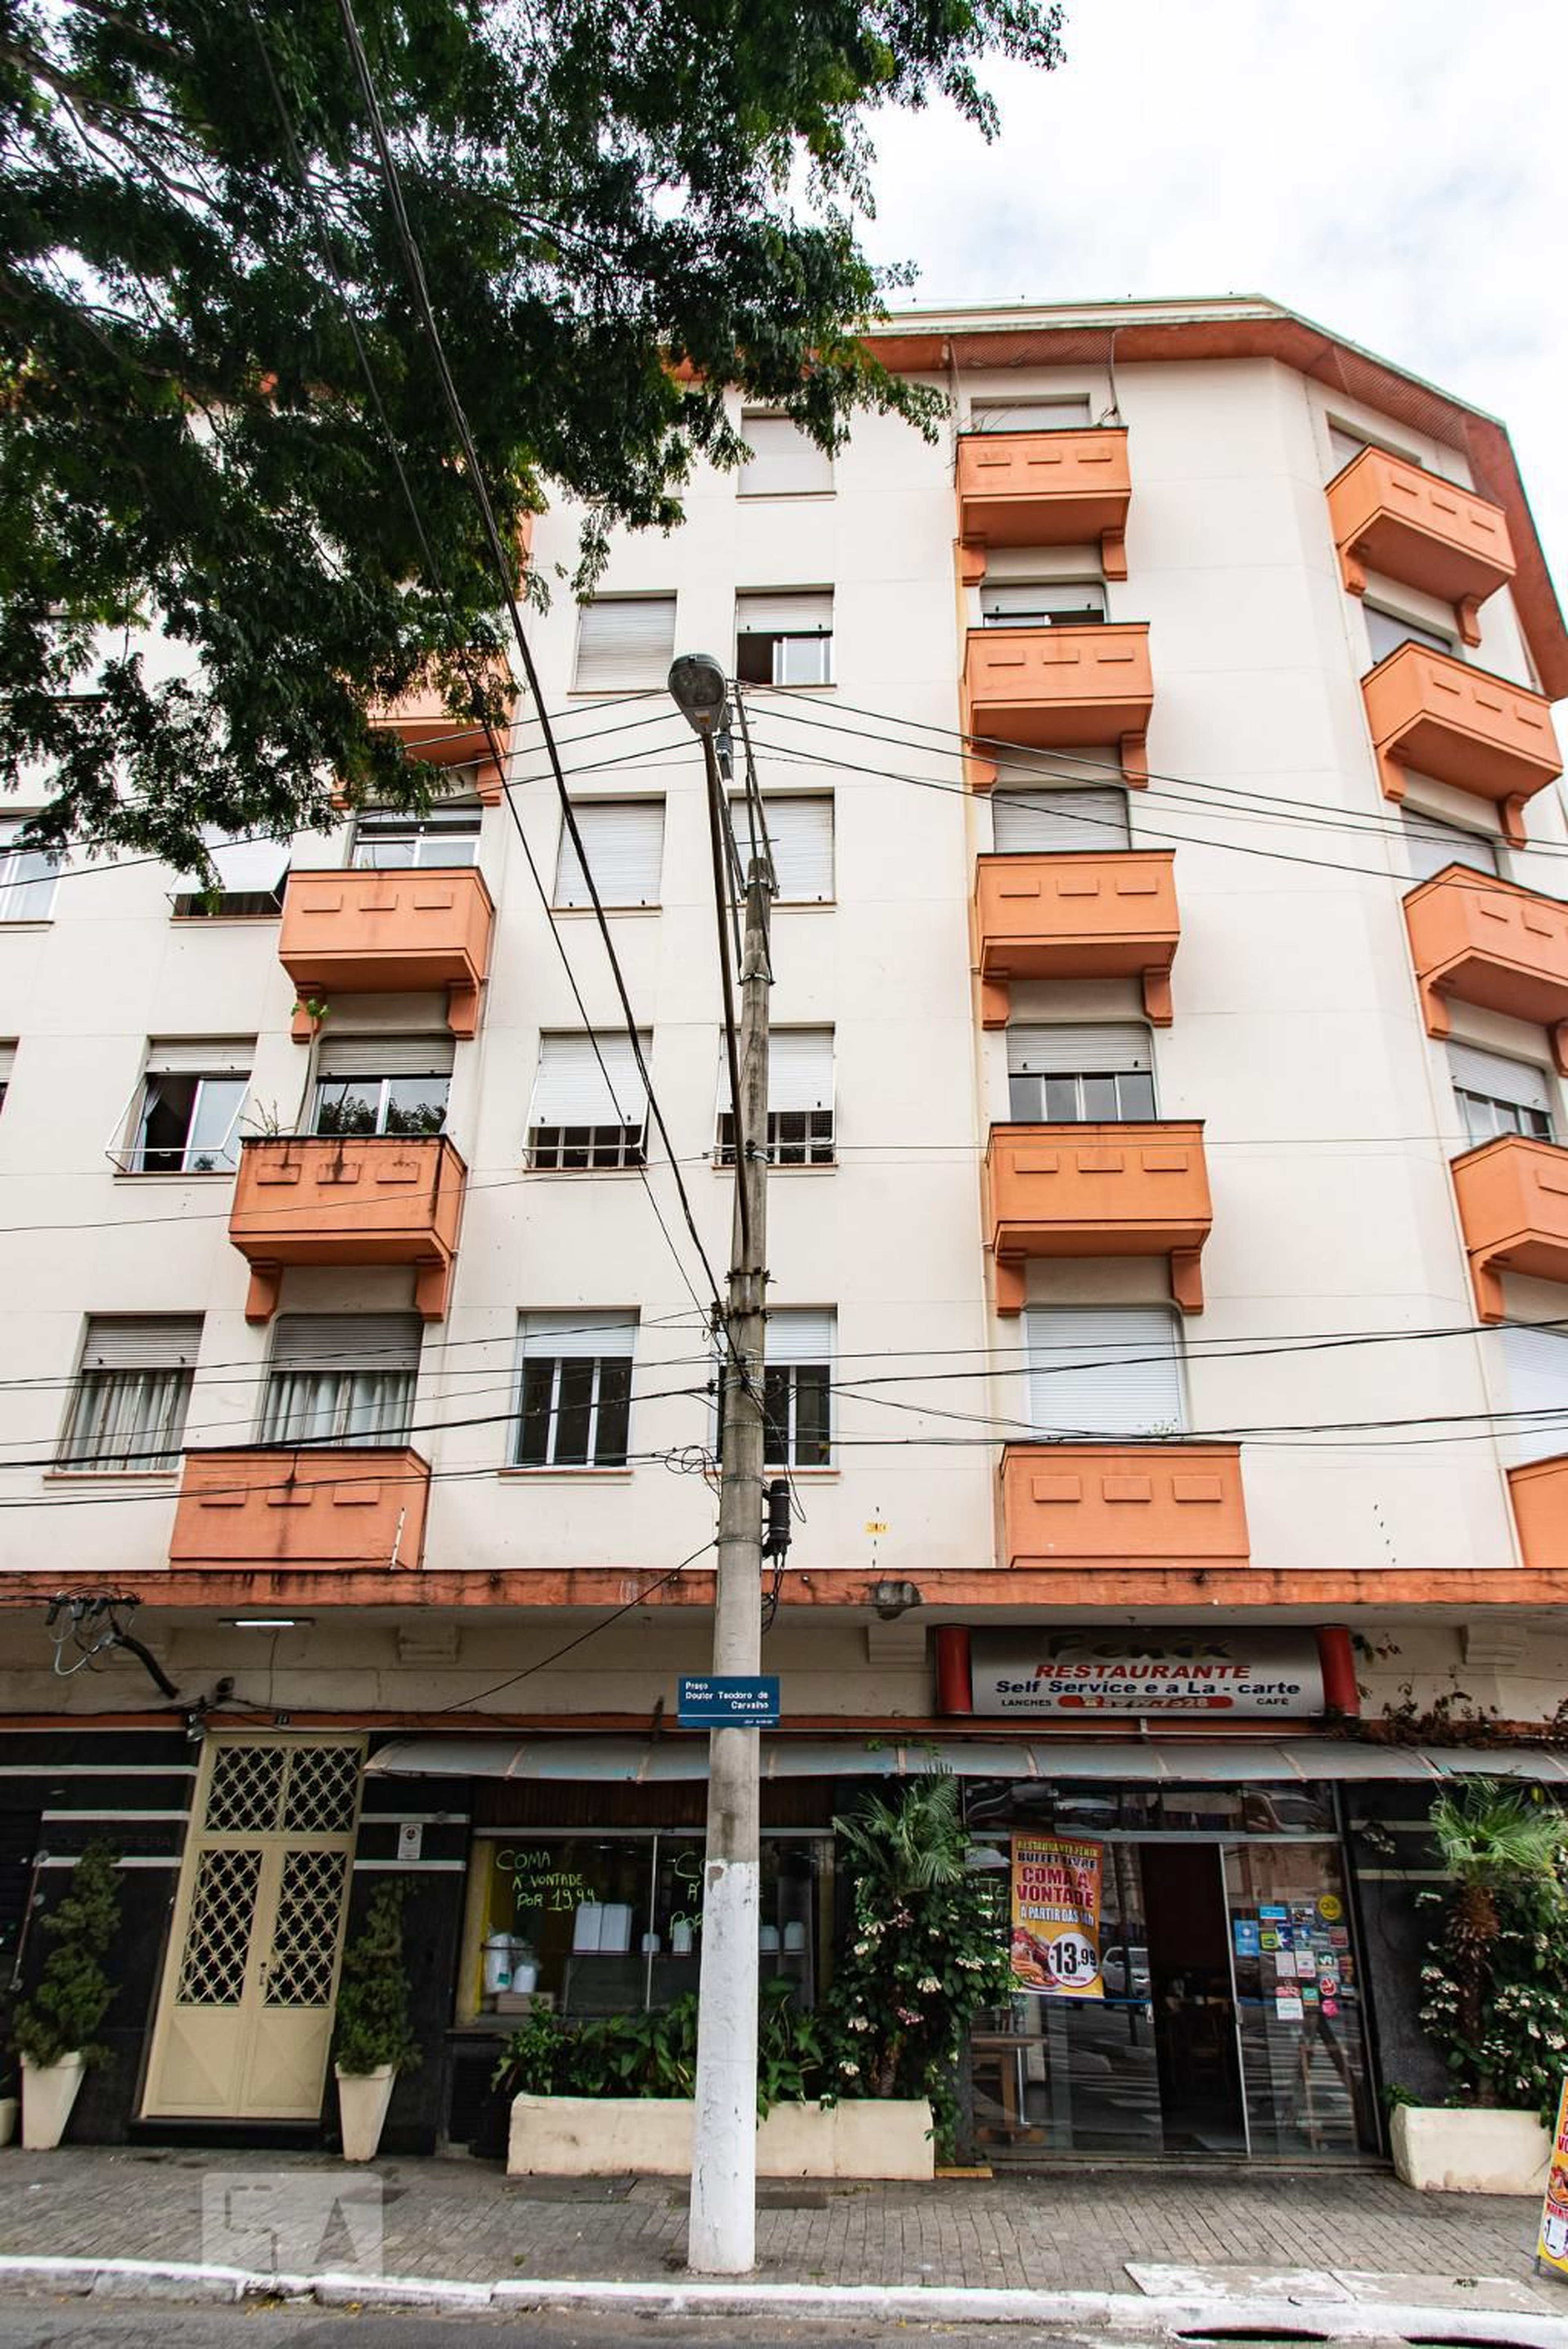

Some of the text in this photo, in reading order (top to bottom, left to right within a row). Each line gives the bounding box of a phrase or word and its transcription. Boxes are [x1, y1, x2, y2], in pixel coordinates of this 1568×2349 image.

[1035, 1665, 1250, 1679] RESTAURANTE
[996, 1681, 1041, 1693] Self
[1048, 1680, 1137, 1693] Service
[1145, 1684, 1158, 1693] e
[1165, 1684, 1178, 1693] a
[1187, 1681, 1216, 1694] La
[1238, 1682, 1300, 1694] carte
[731, 1701, 769, 1710] Carvalho
[495, 1849, 551, 1870] COMA
[531, 1873, 583, 1888] VONTADE
[1022, 1867, 1073, 1885] COMA
[517, 1893, 543, 1911] POR
[1016, 1885, 1093, 1908] VONTADE
